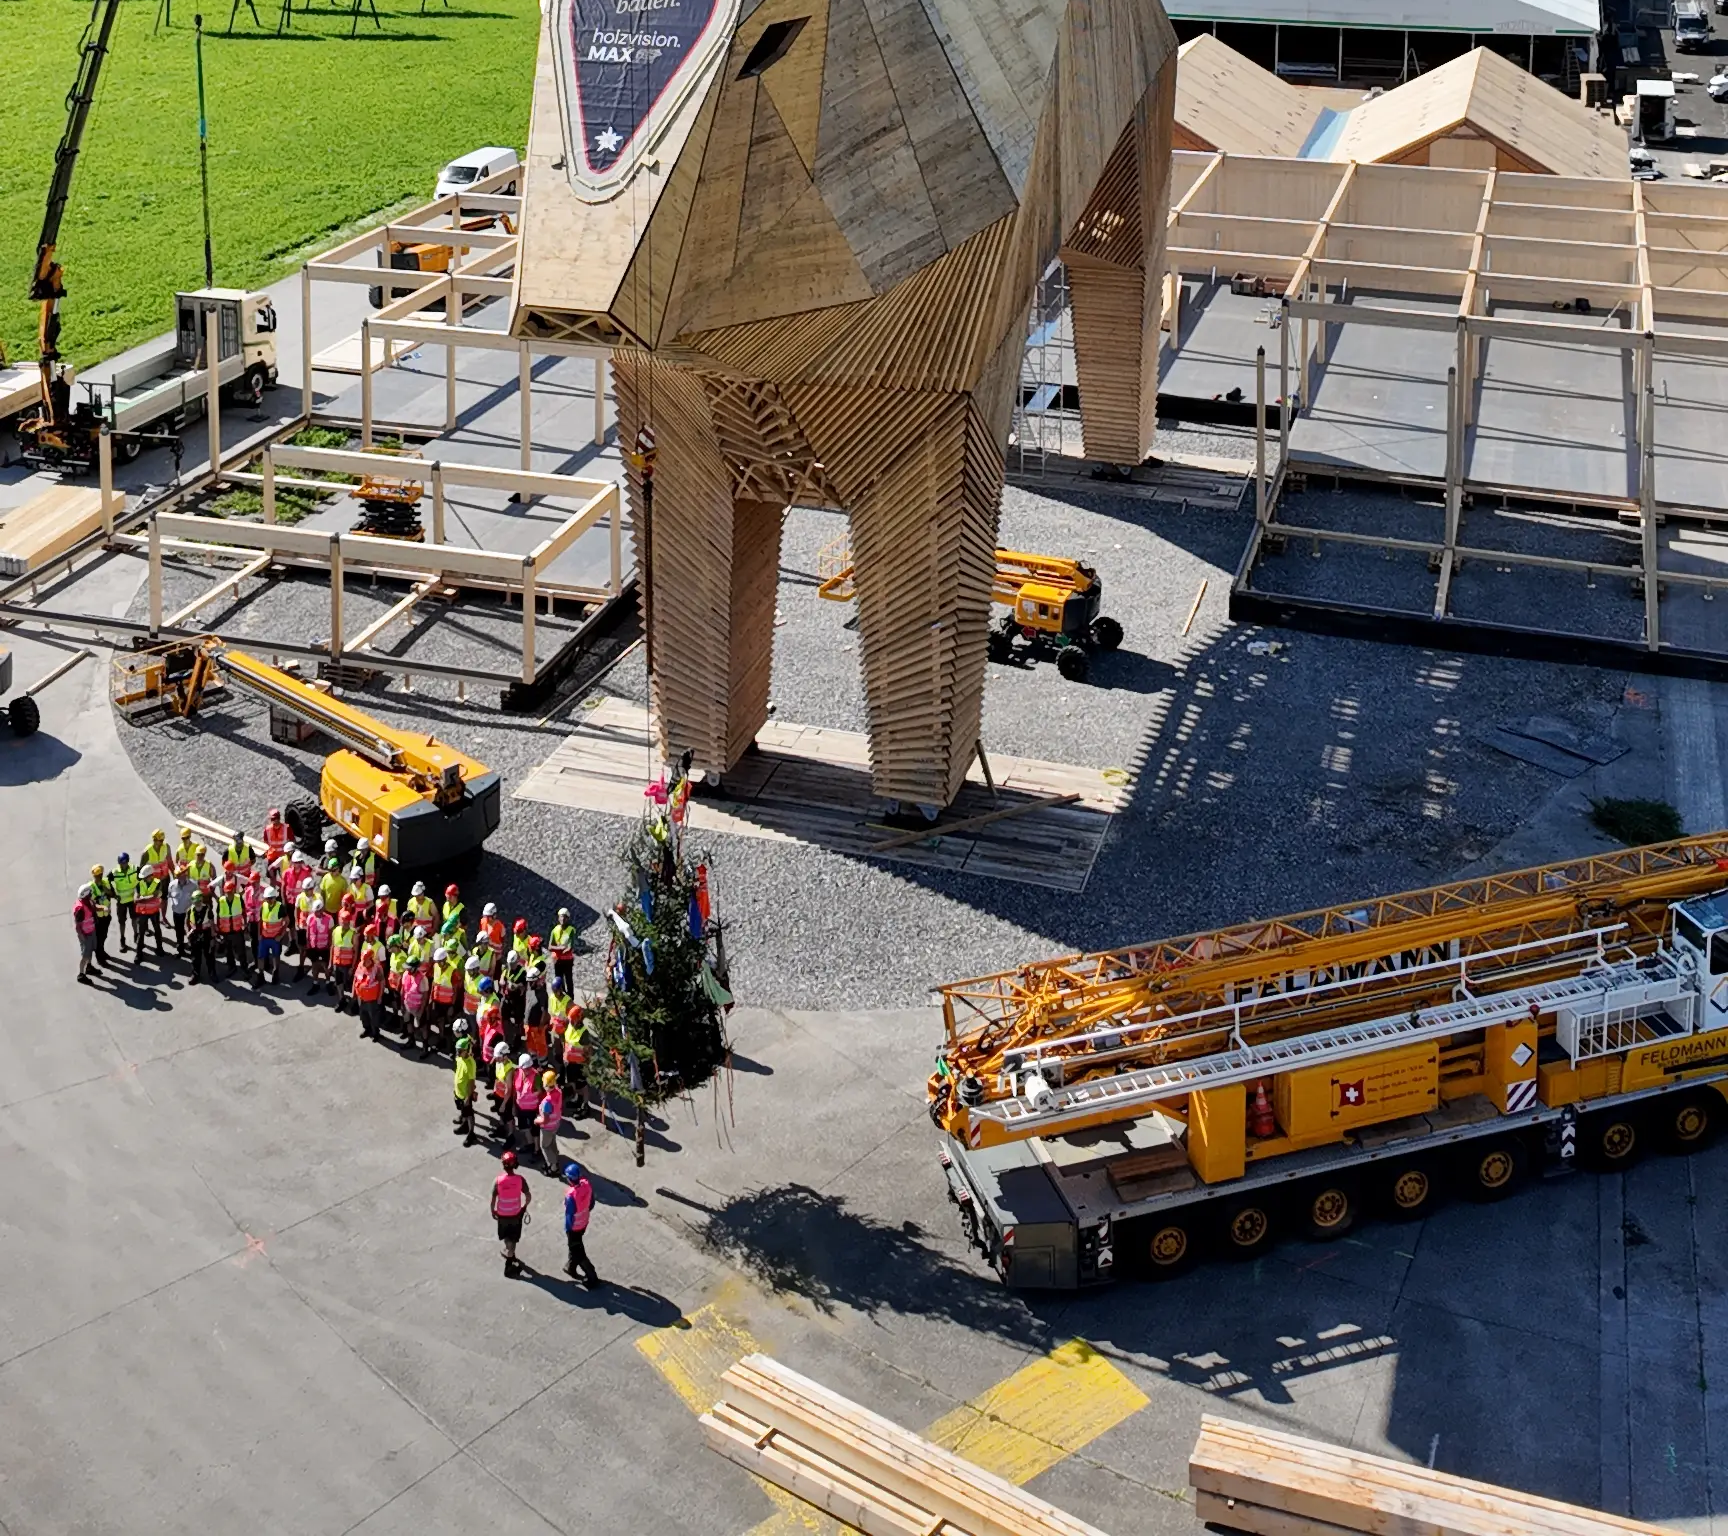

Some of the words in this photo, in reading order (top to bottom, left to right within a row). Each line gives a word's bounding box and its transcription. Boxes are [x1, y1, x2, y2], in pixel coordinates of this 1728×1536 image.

[592, 27, 681, 48] holzvision.
[587, 45, 635, 62] MAX
[1640, 1035, 1728, 1066] FELDMANN
